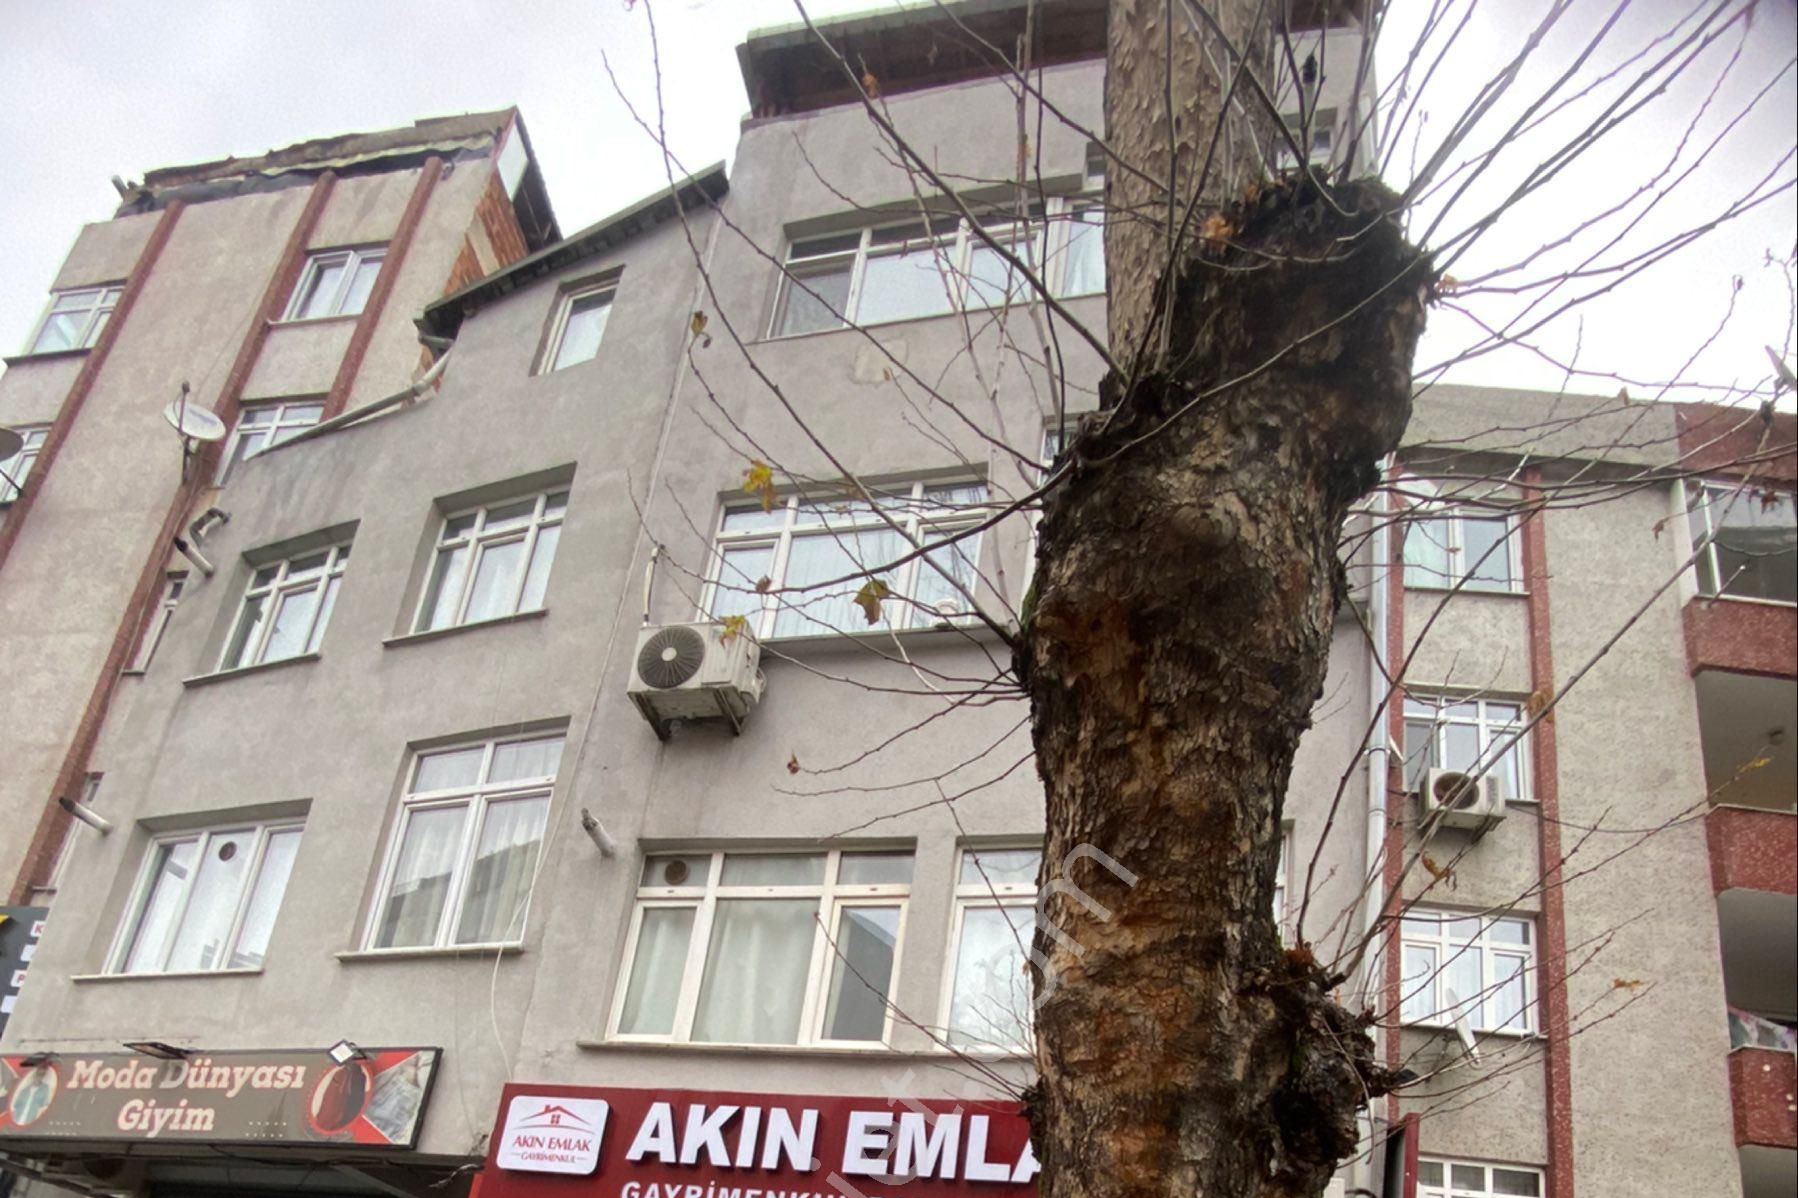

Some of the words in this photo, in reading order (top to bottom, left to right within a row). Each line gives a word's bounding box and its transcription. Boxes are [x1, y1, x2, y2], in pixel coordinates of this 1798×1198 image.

[66, 1059, 158, 1090] Moda
[159, 1058, 307, 1099] Dünyası
[117, 1098, 216, 1138] Giyim
[512, 1134, 546, 1149] AKIN
[548, 1136, 592, 1152] EMLAK
[625, 1102, 819, 1171] AKIN
[842, 1111, 1042, 1183] EML
